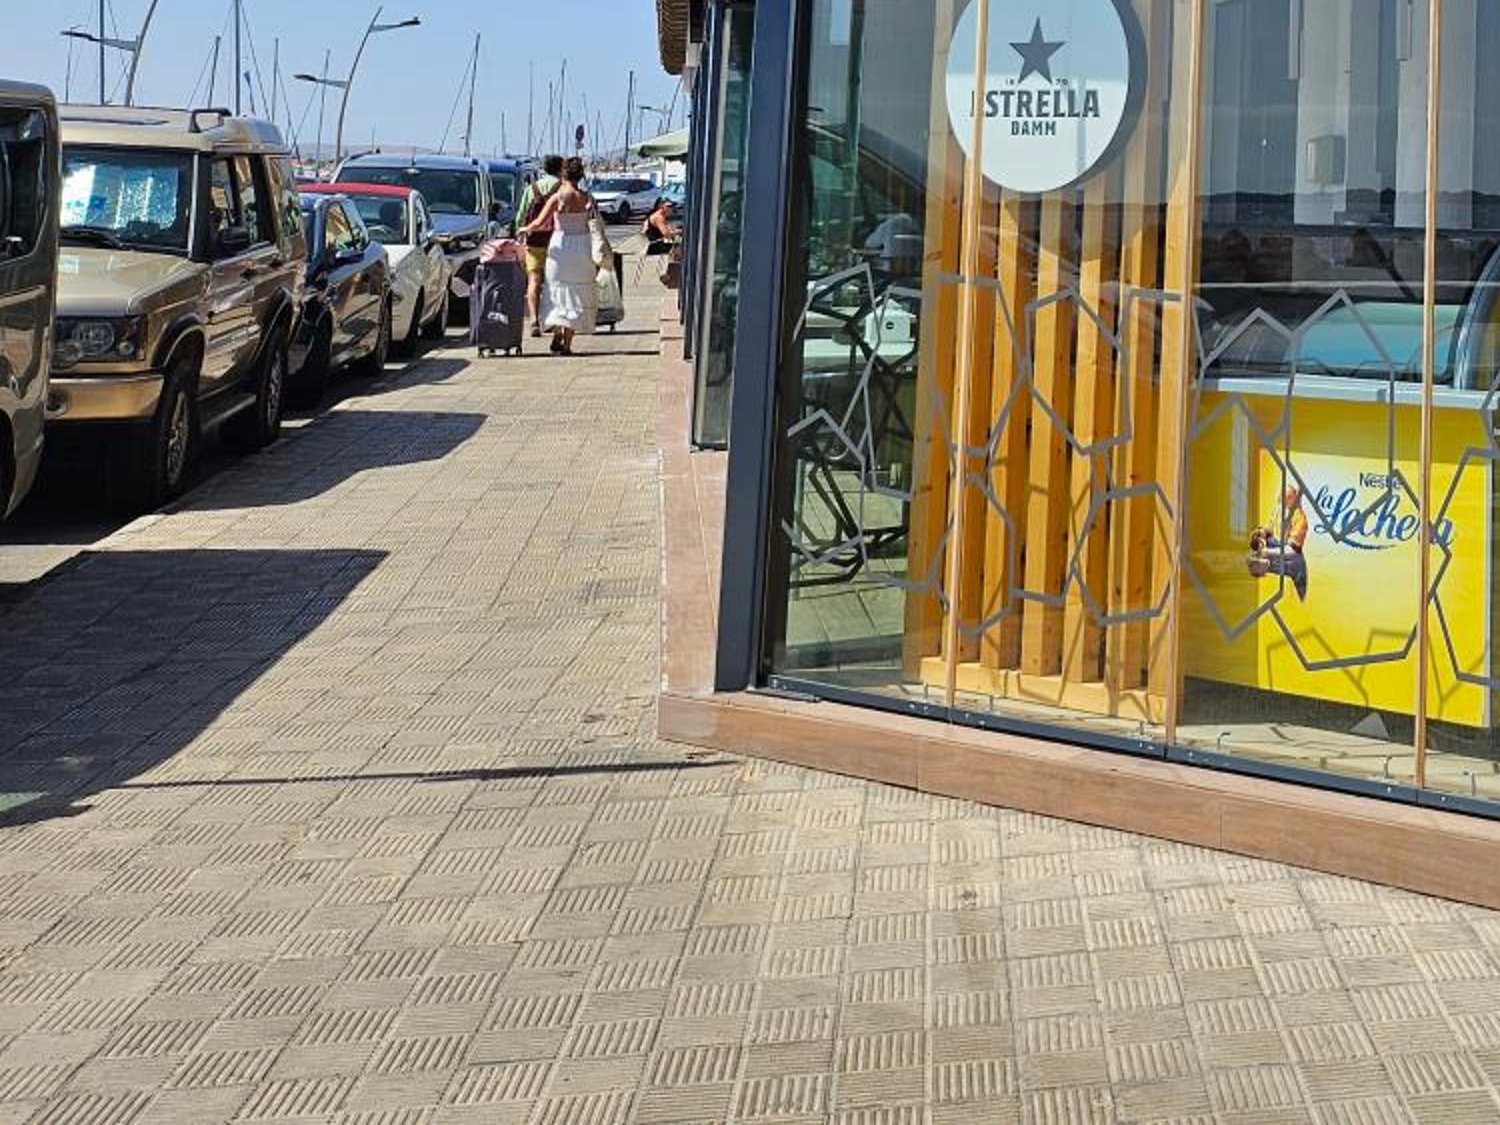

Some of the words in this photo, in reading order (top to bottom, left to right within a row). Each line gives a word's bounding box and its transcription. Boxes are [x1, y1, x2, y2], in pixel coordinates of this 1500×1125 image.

[969, 90, 1100, 117] STRELLA
[1011, 120, 1056, 136] DAMM
[1315, 485, 1334, 510] la
[1314, 487, 1454, 546] Lechea
